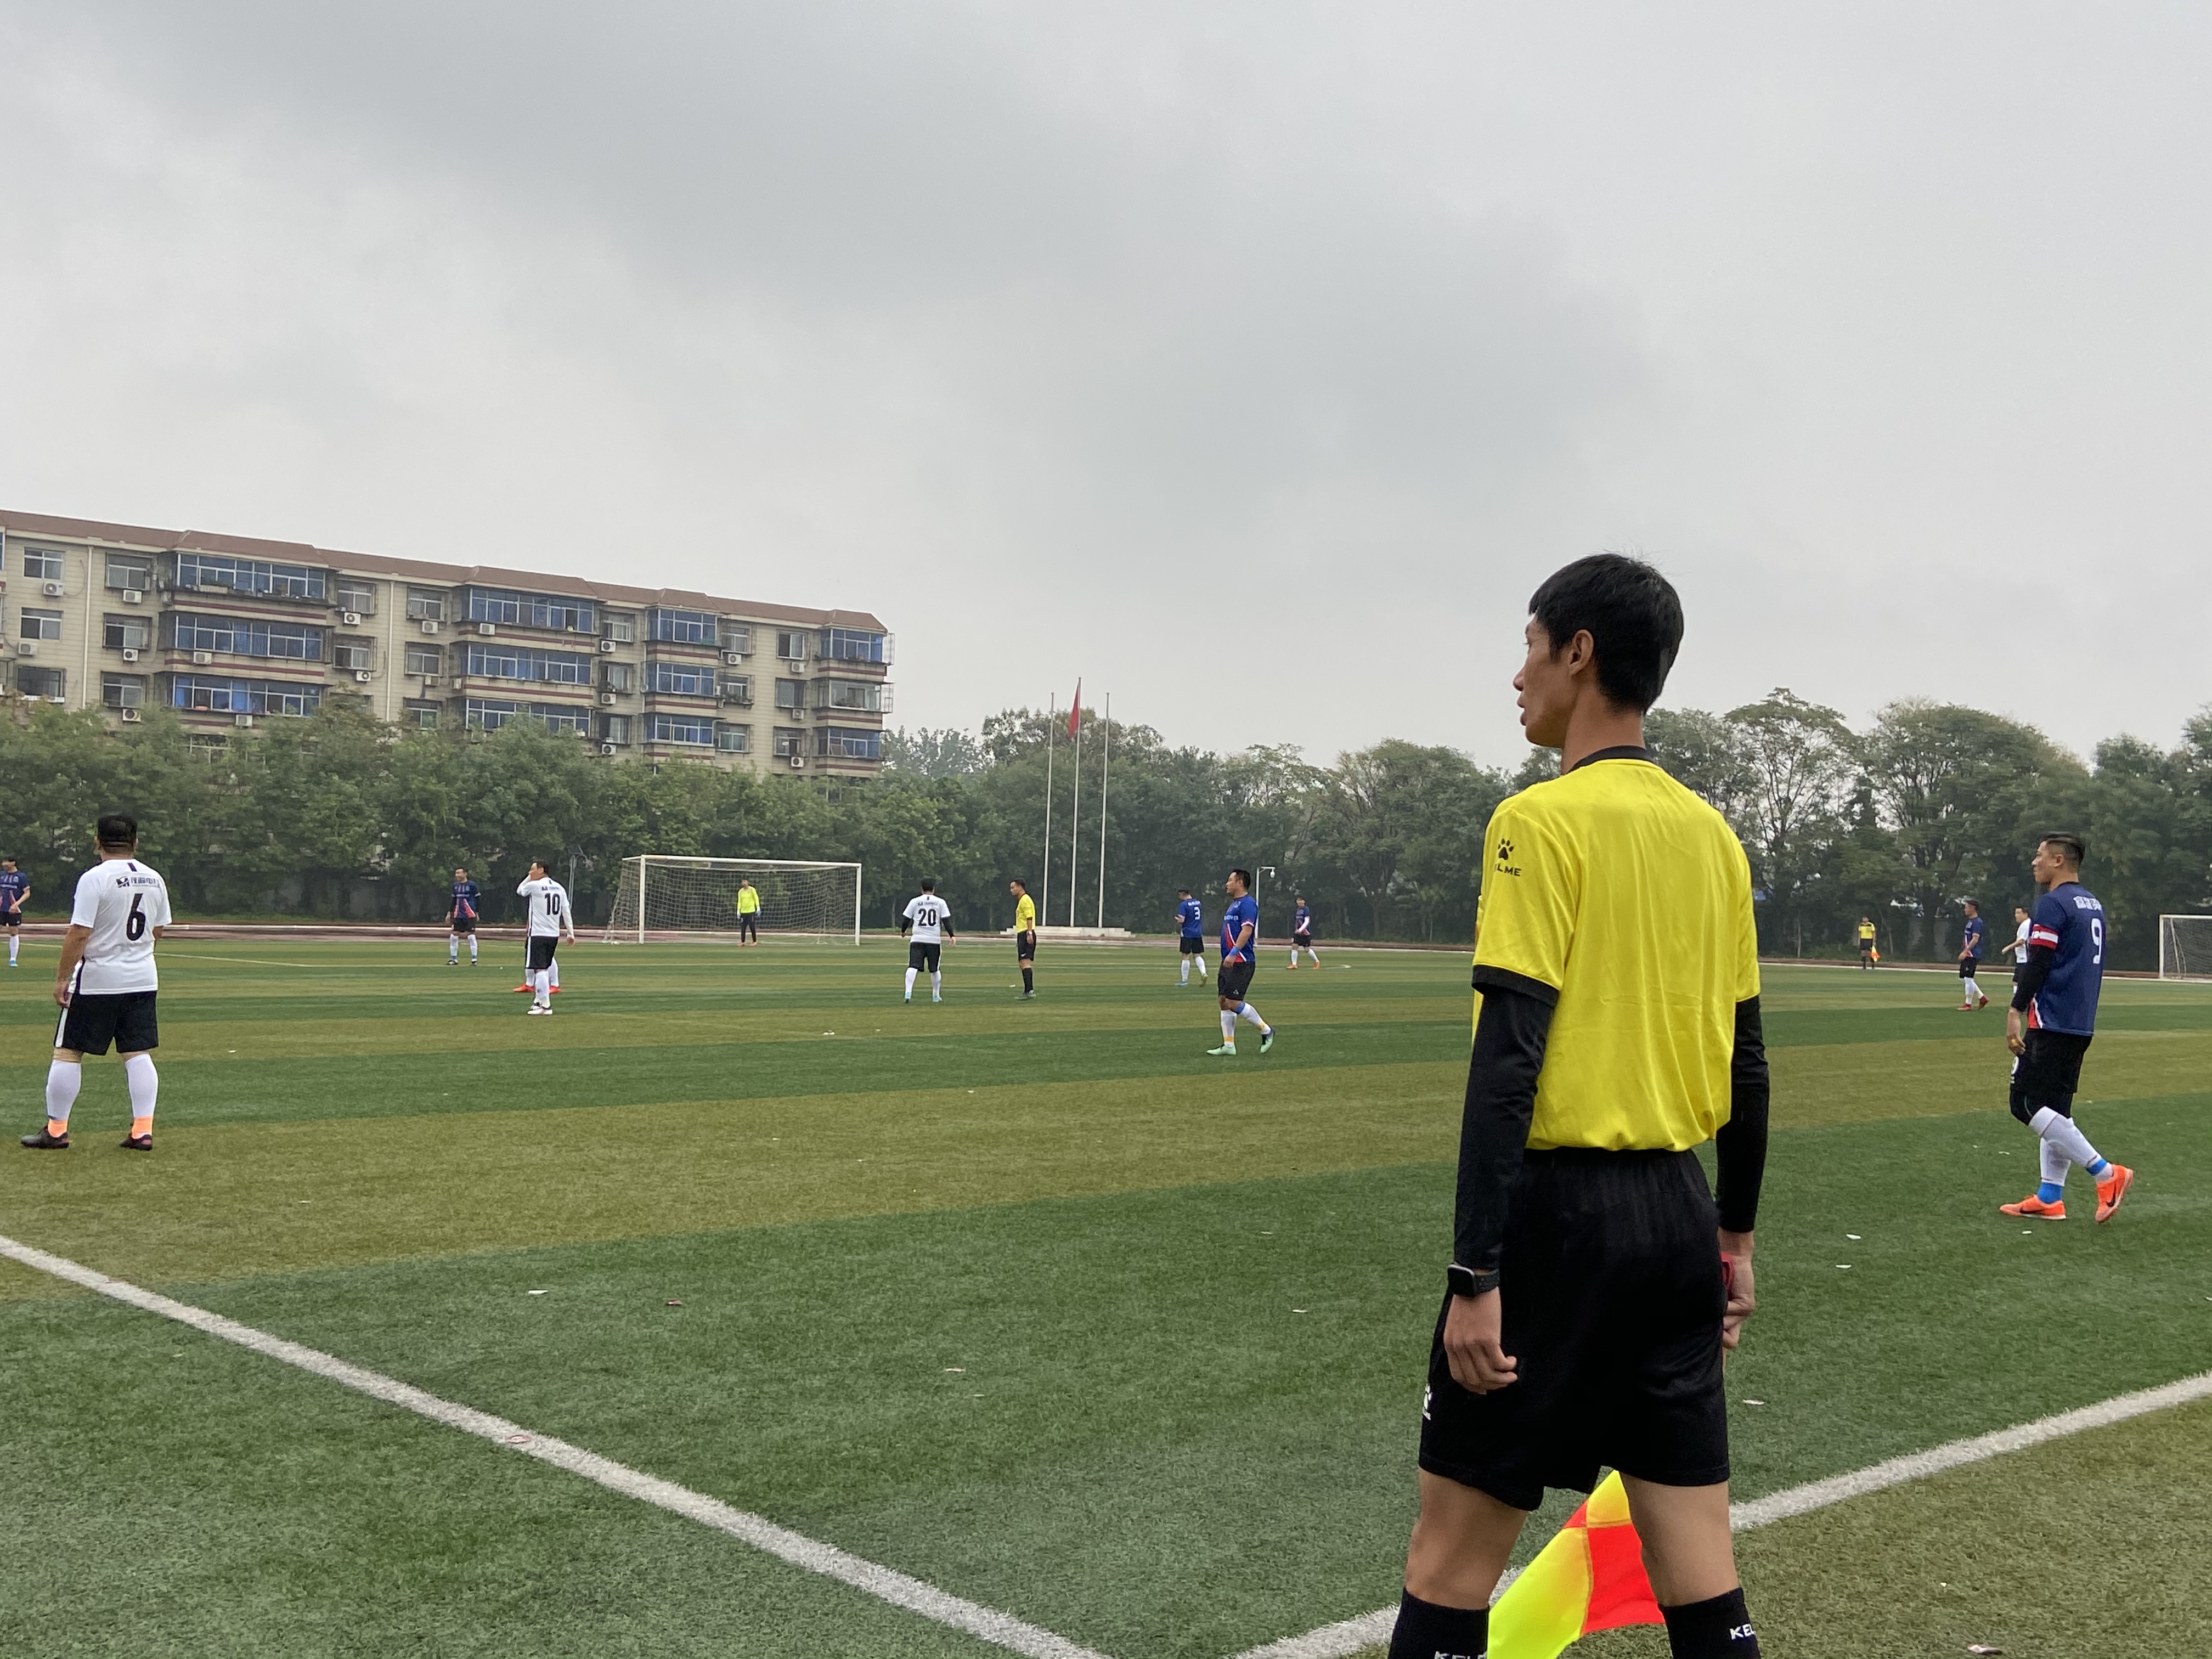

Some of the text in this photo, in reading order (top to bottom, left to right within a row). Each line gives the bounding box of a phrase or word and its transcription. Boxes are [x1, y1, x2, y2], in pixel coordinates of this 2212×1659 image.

[1494, 863, 1522, 877] LME
[545, 893, 560, 915] 10
[126, 893, 145, 941] 6
[918, 909, 936, 926] 20
[1194, 907, 1200, 920] 3
[2091, 918, 2102, 964] 9
[1730, 1624, 1756, 1640] KEL
